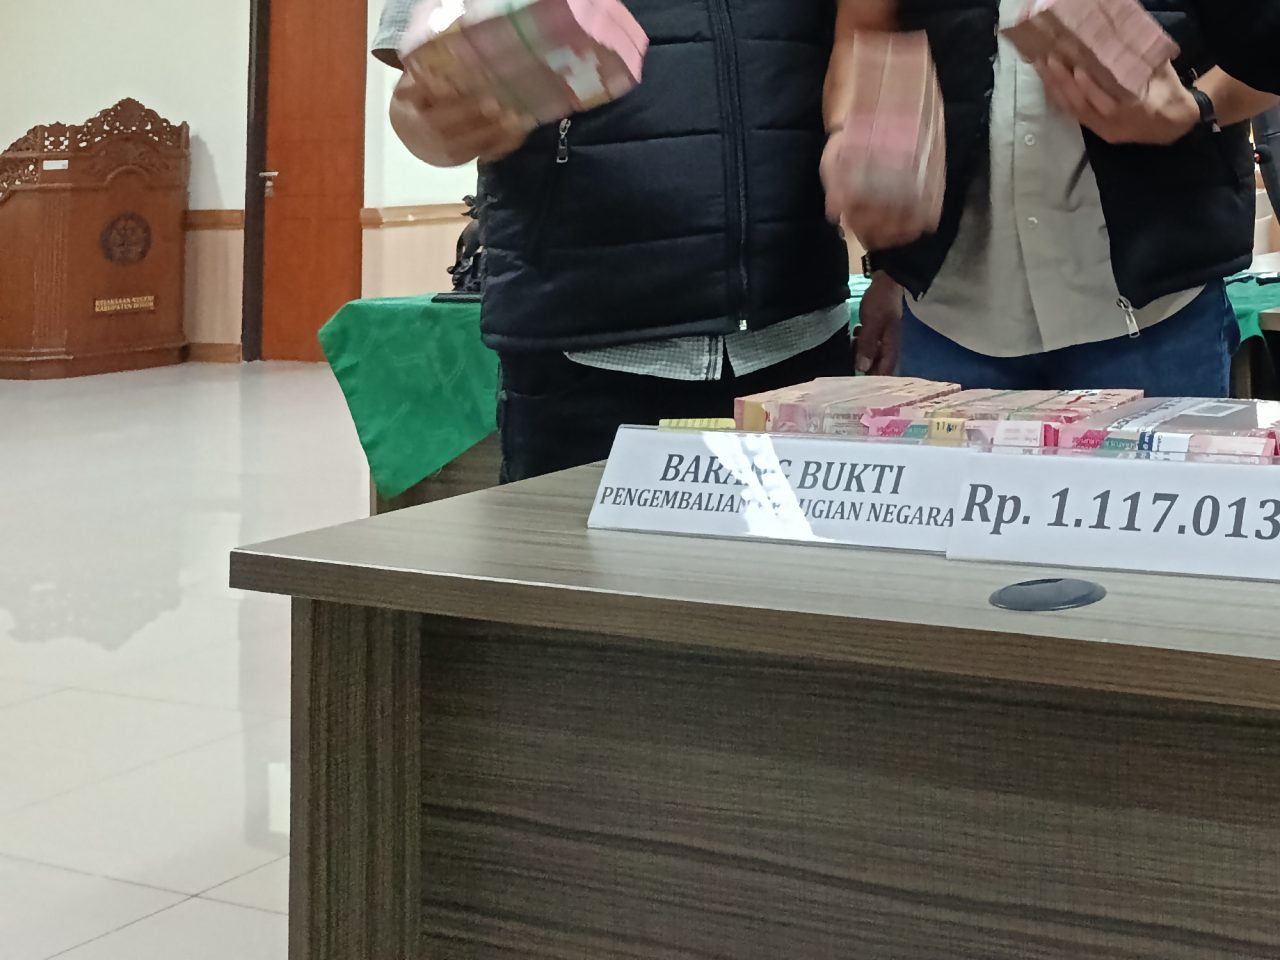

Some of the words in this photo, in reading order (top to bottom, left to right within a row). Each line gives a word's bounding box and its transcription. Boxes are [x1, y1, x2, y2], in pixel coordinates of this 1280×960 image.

[659, 453, 792, 486] BAR
[797, 460, 906, 494] BUKTI
[765, 495, 863, 521] UGIAN
[866, 502, 954, 528] NEGARA
[961, 483, 1030, 535] Rp.
